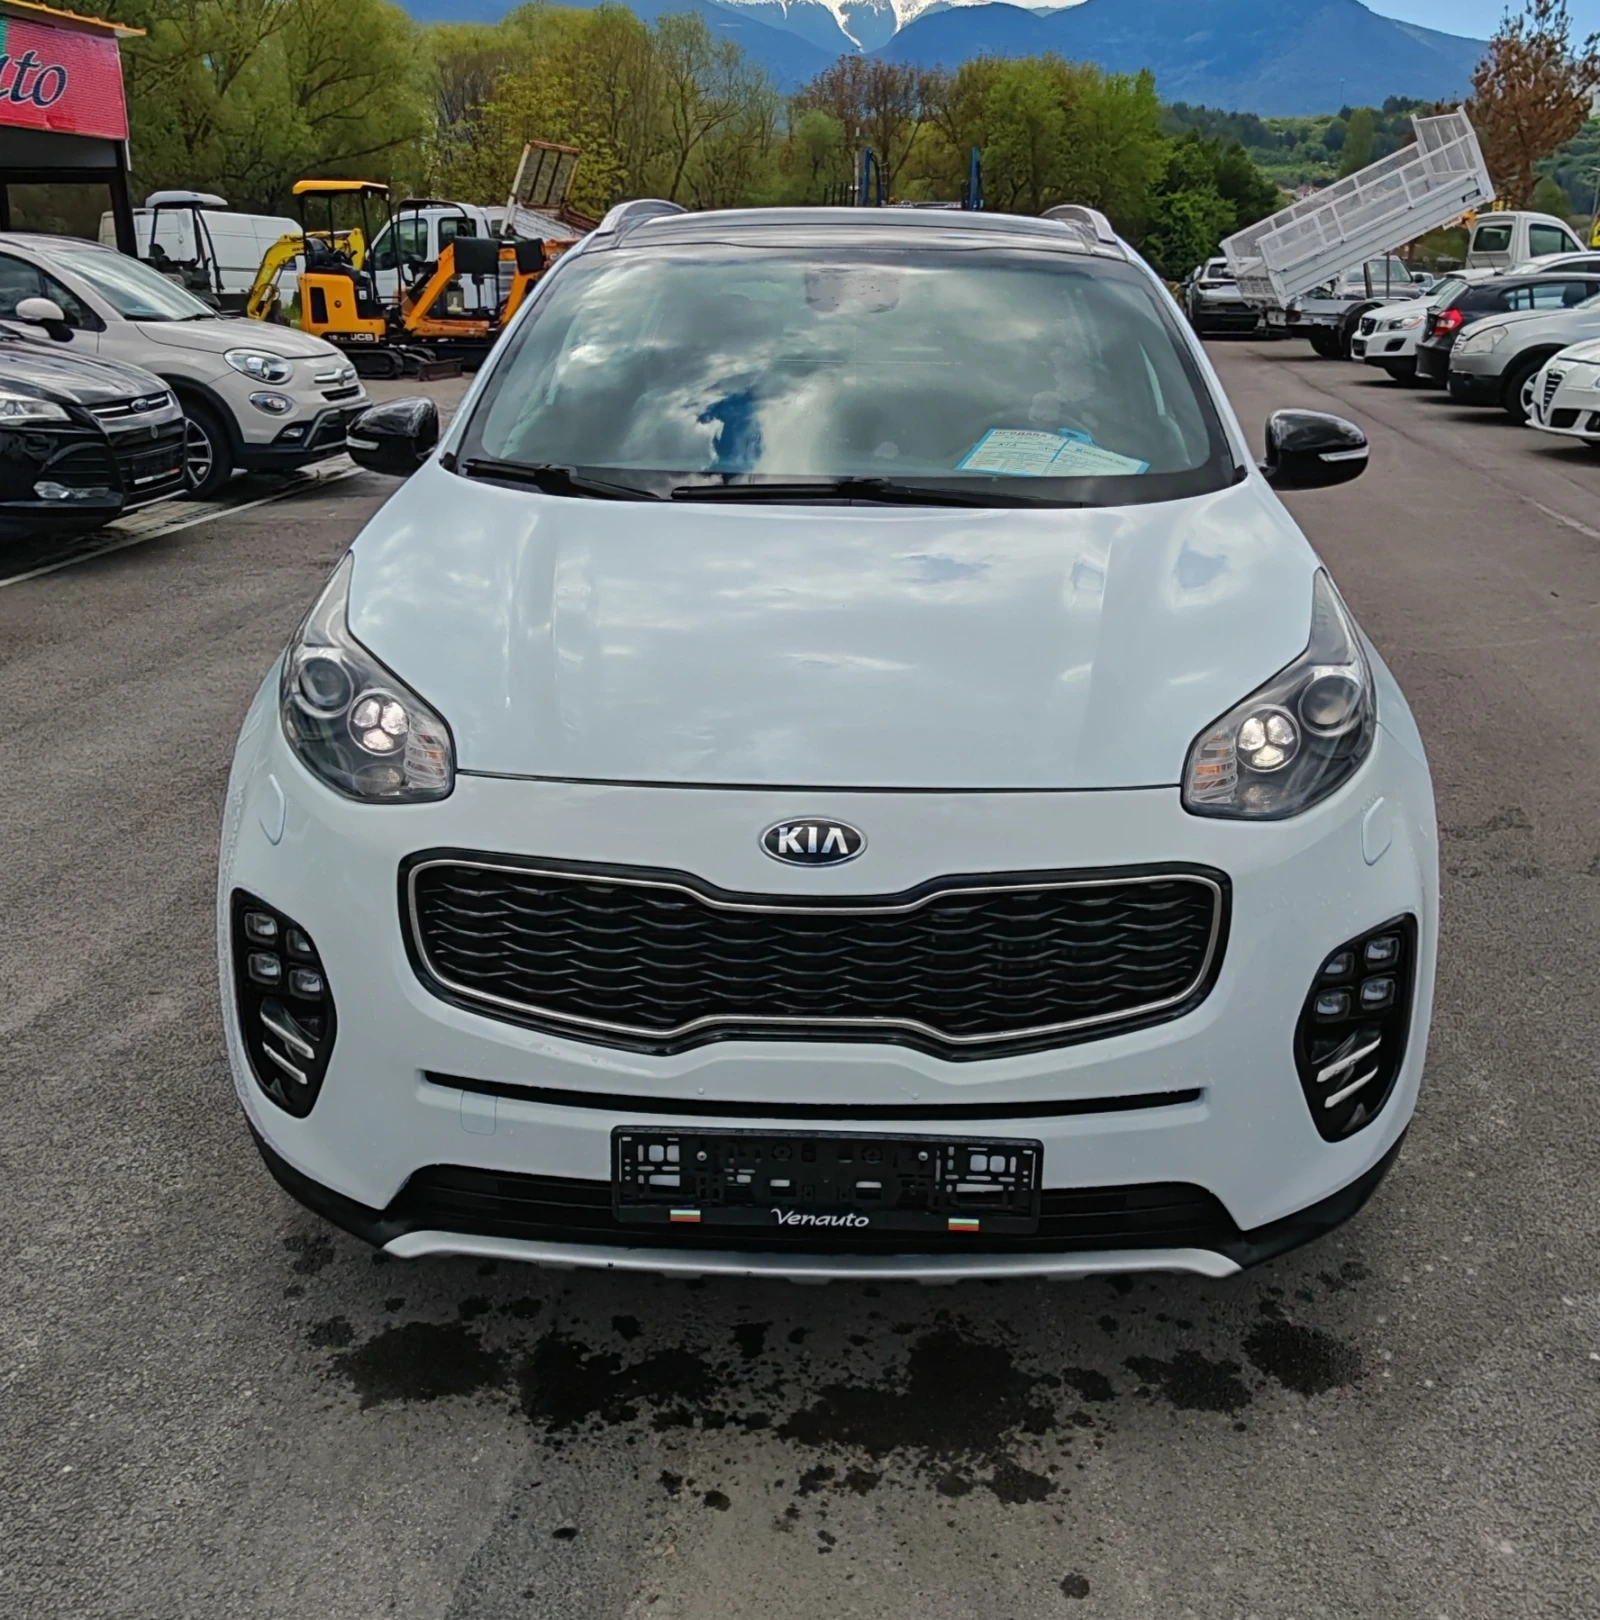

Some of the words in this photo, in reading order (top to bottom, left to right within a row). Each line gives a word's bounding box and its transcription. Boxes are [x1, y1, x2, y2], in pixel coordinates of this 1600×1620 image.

[0, 49, 68, 108] to
[350, 333, 374, 341] JCB
[778, 826, 849, 855] KIA
[770, 1208, 870, 1228] Venauto
